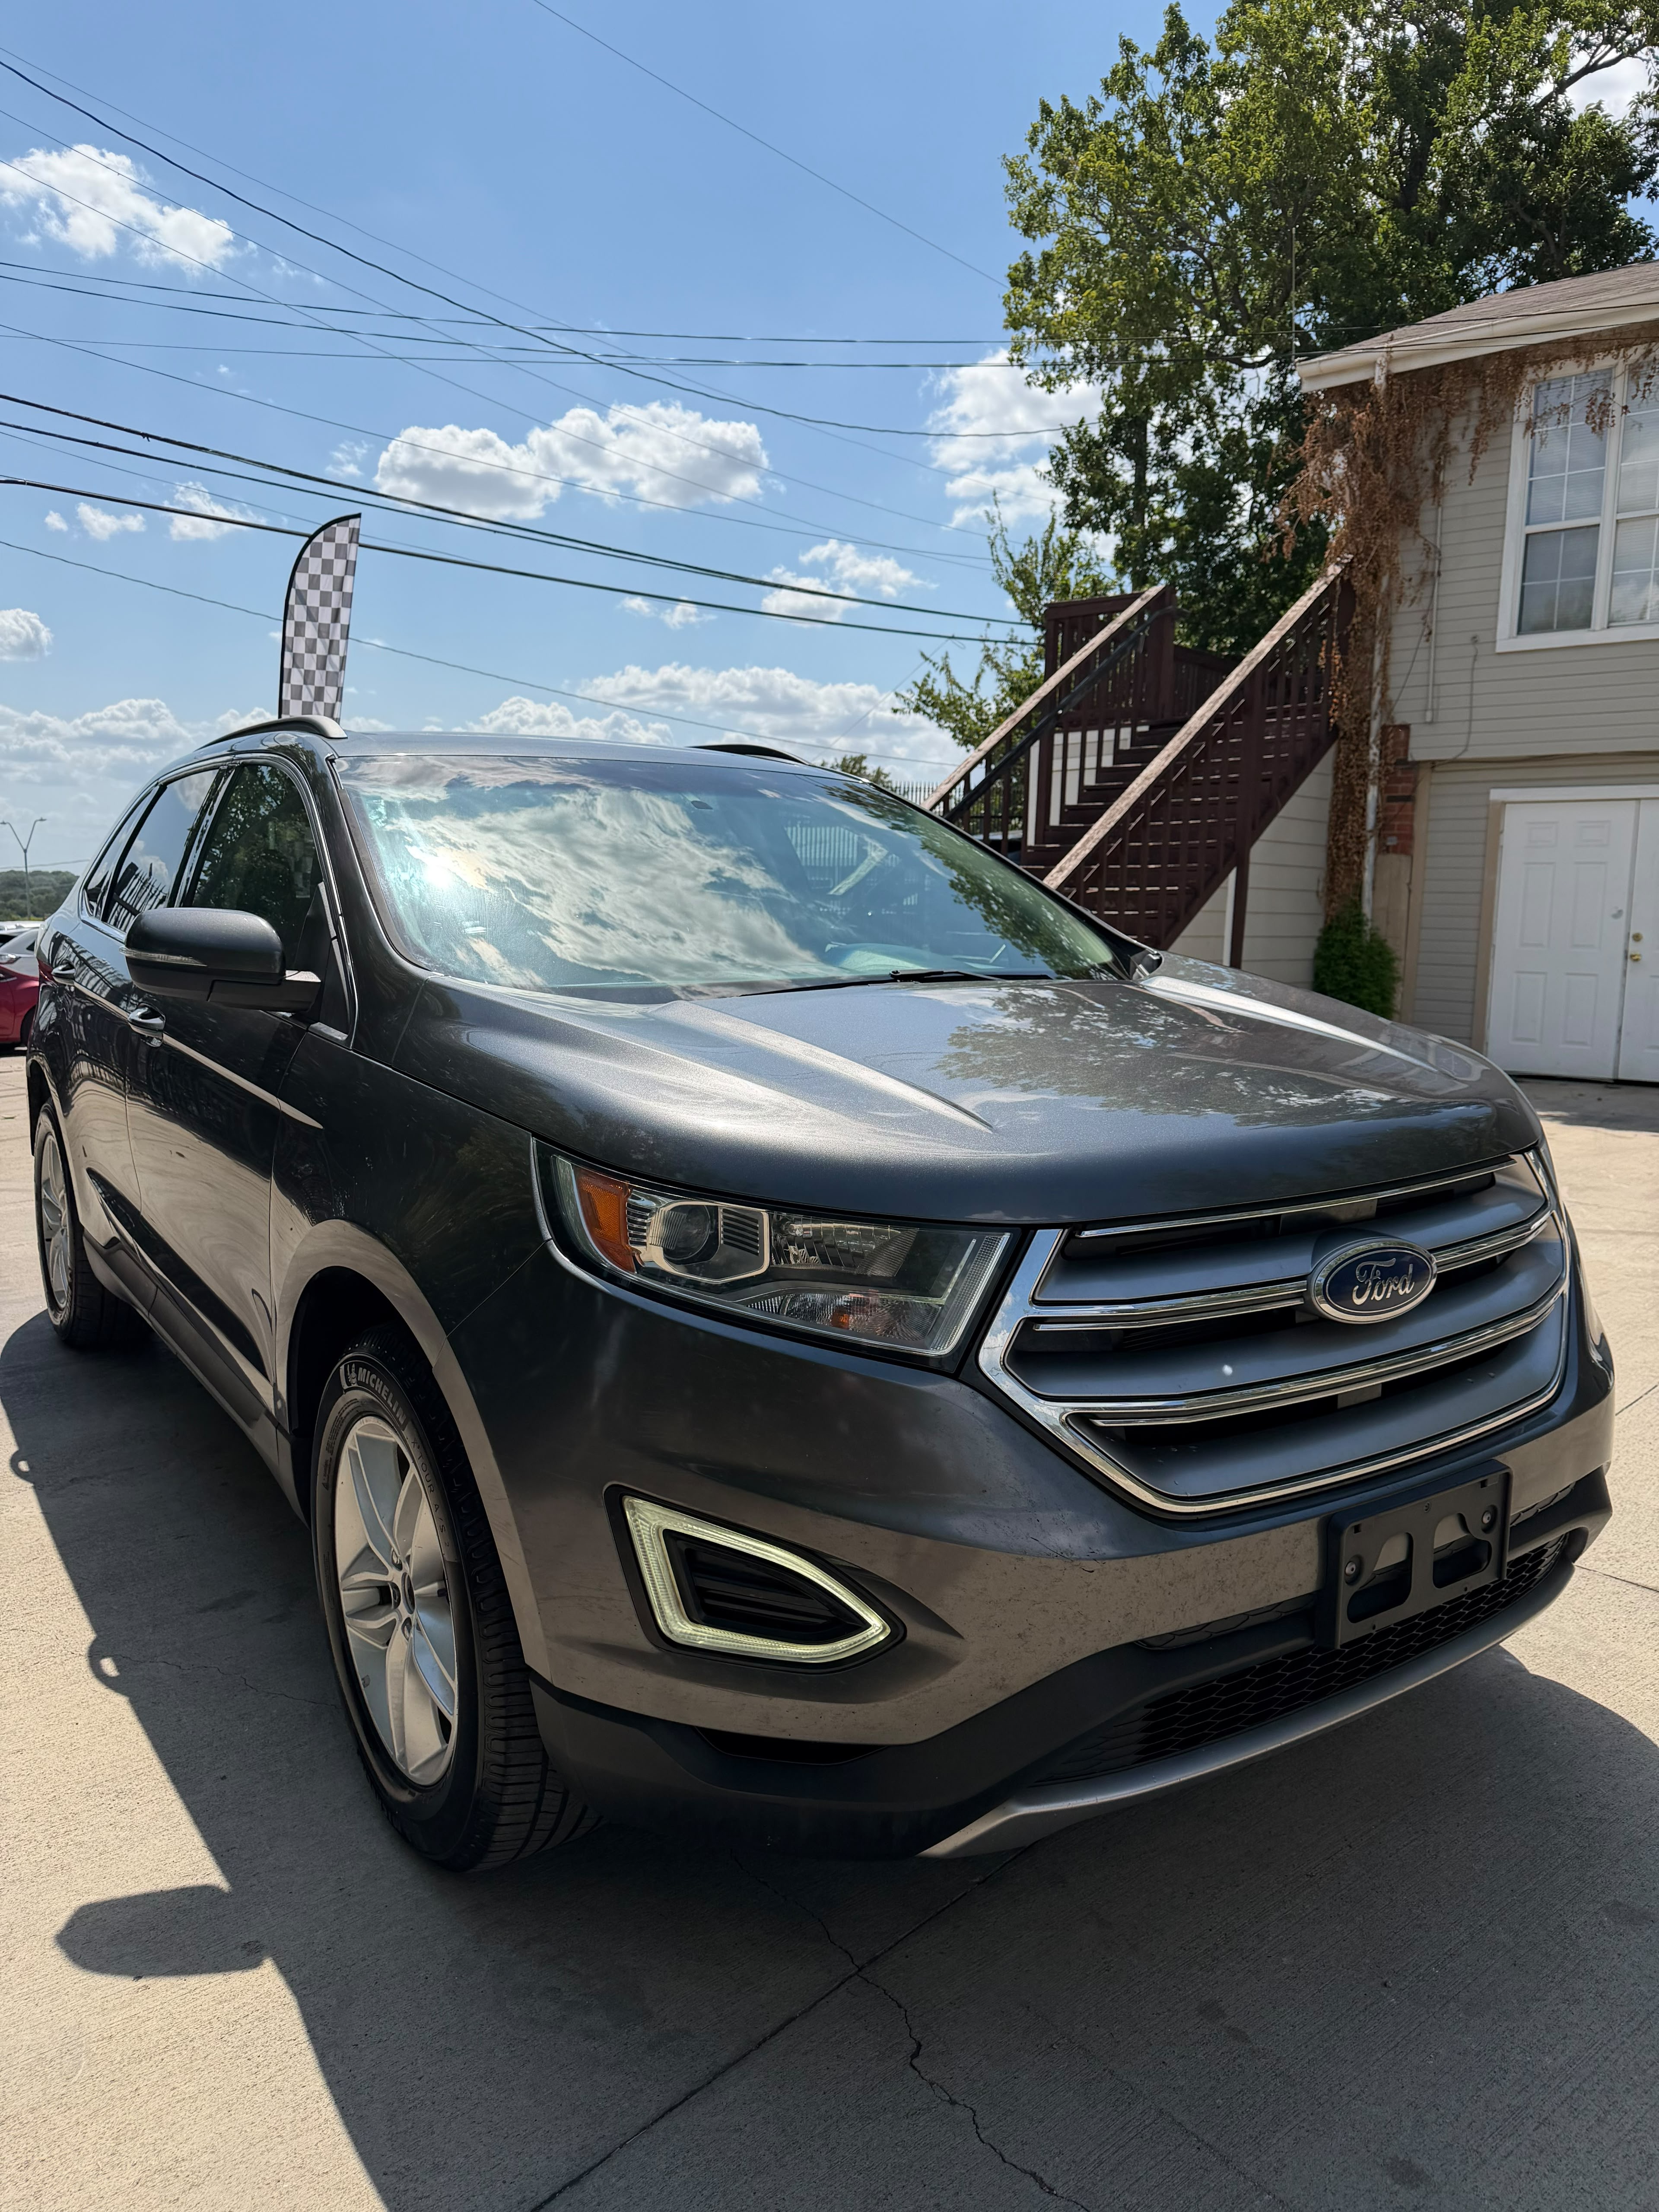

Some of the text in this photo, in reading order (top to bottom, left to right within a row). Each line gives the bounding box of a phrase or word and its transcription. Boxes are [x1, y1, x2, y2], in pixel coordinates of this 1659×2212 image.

[1352, 1258, 1415, 1305] Ford
[358, 1367, 407, 1425] MICHELIN
[418, 1452, 435, 1493] TOUR
[434, 1503, 446, 1533] A/S
